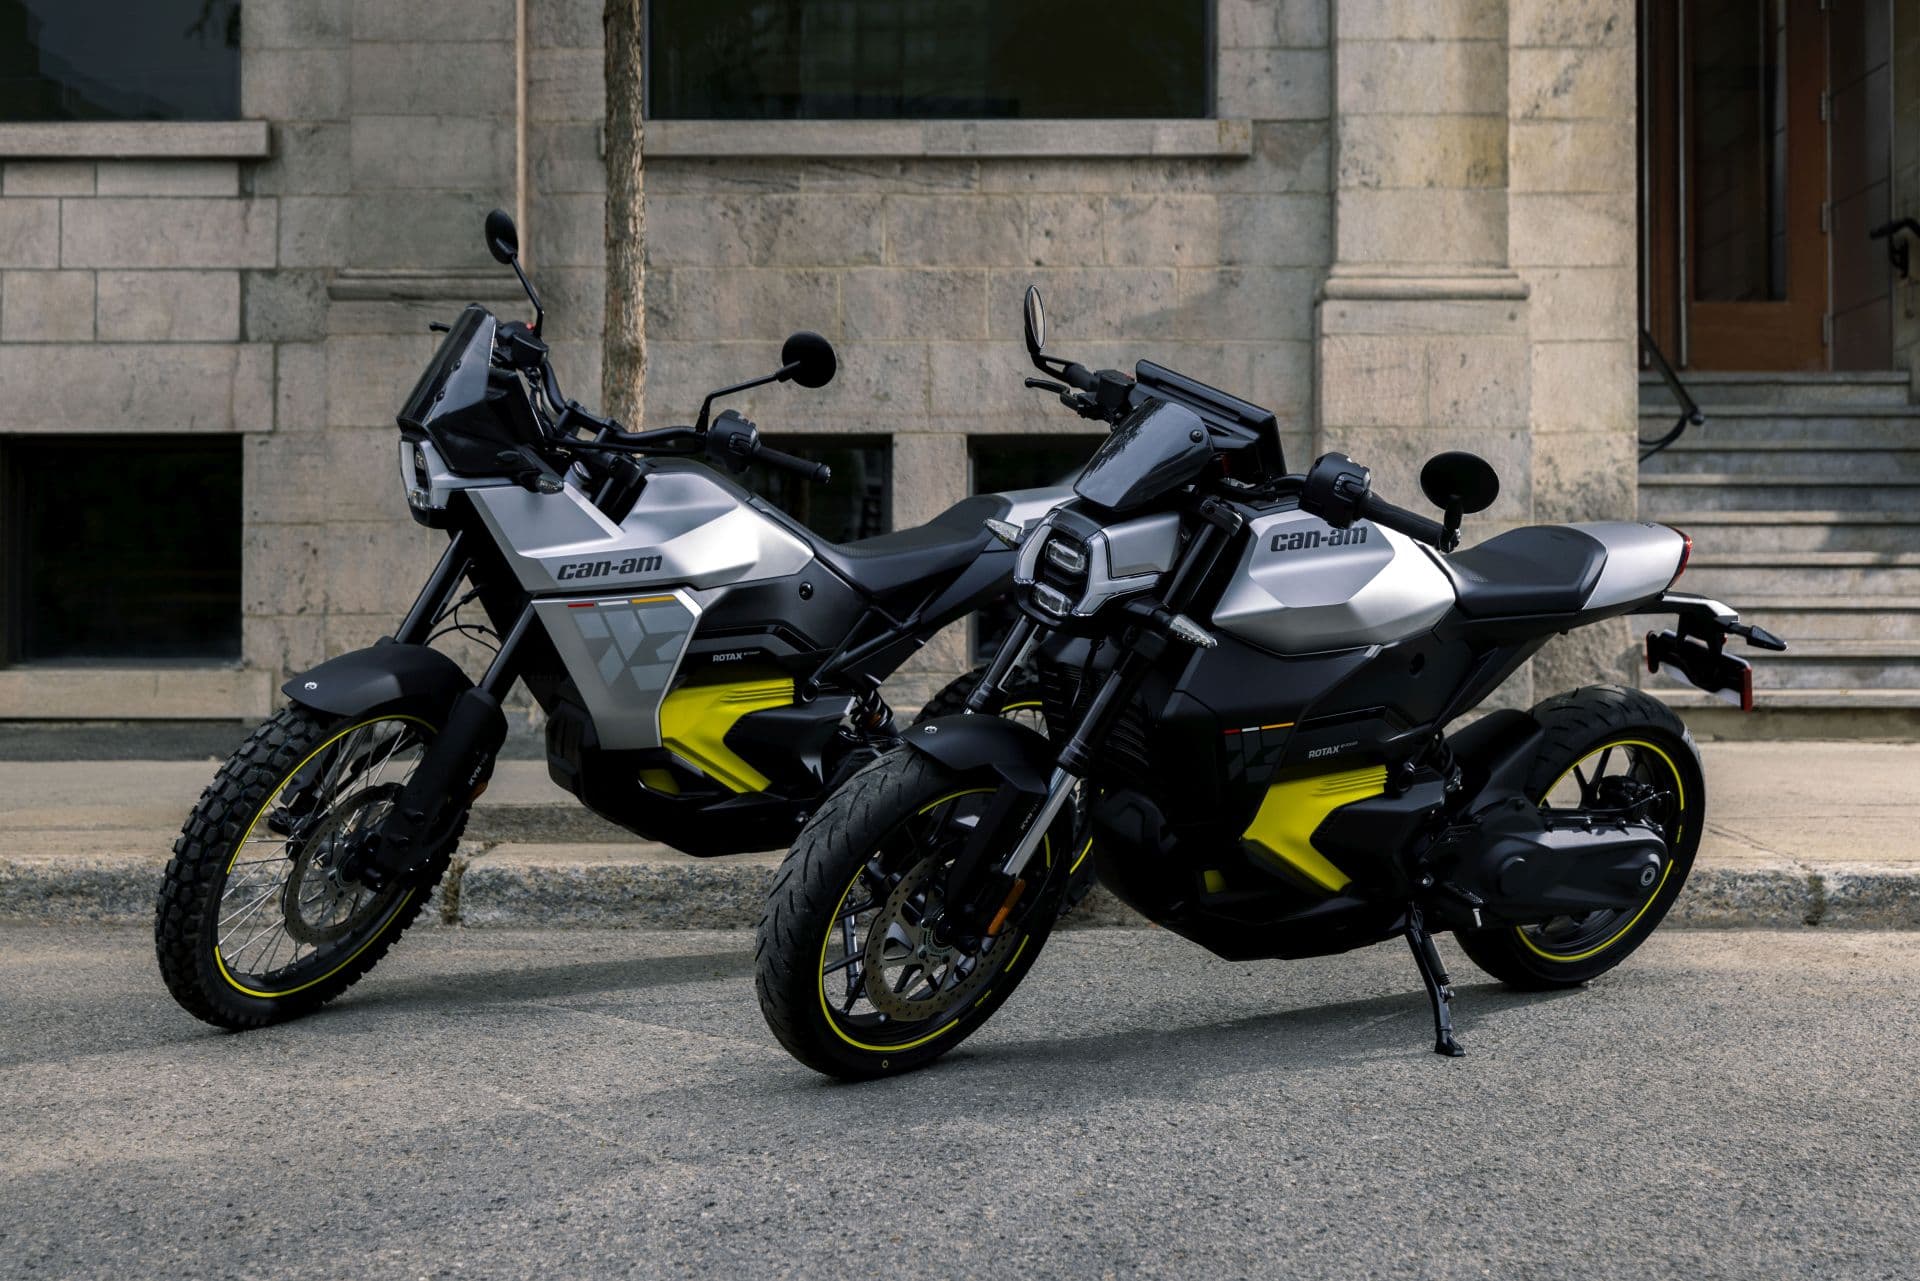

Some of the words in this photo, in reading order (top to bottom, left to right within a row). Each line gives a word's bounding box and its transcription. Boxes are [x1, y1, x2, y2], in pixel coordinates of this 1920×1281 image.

[1271, 526, 1368, 552] can-am
[557, 555, 662, 580] can-am
[712, 652, 743, 662] ROTAX
[1308, 745, 1340, 759] ROTAX
